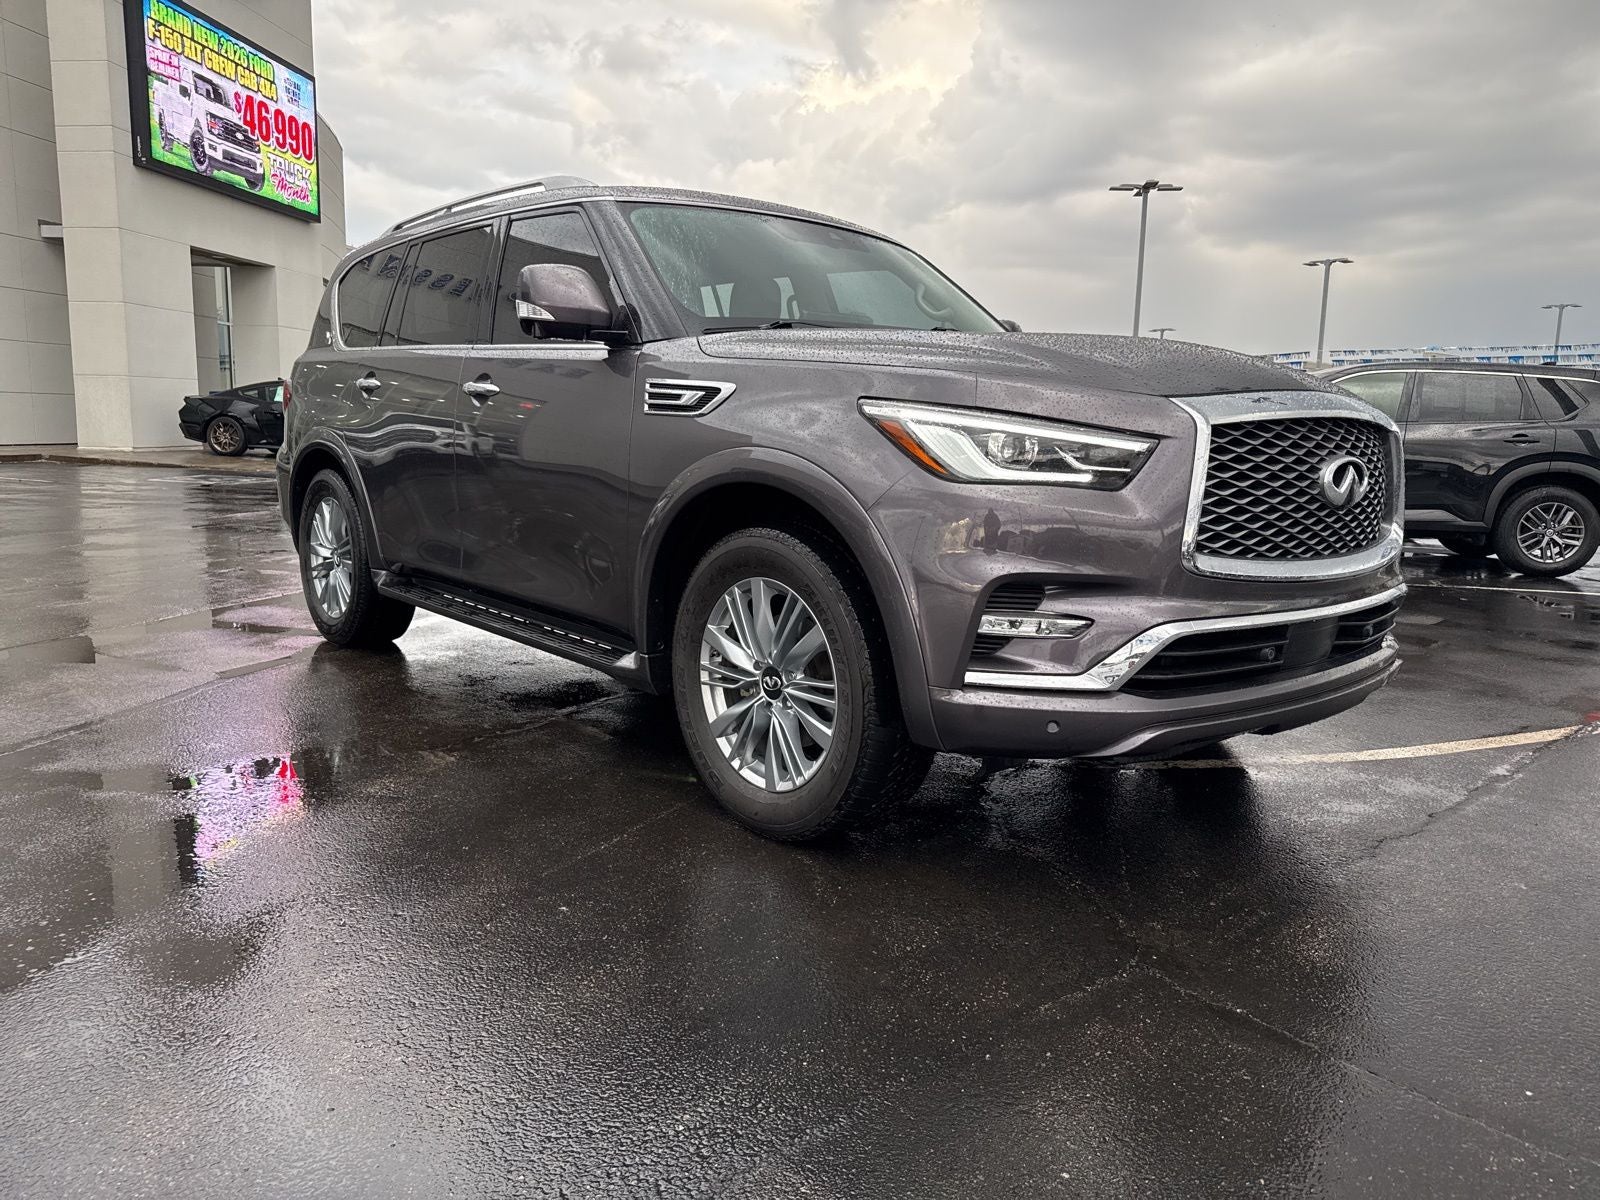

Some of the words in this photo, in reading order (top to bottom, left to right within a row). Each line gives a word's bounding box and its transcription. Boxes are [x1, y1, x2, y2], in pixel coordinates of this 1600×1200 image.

[147, 17, 182, 54] F-150
[204, 47, 236, 81] CREW
[237, 65, 258, 92] CAB
[150, 0, 191, 38] BRAND
[193, 21, 219, 53] NEW
[220, 36, 248, 68] 2026
[248, 51, 274, 82] FORD
[267, 152, 313, 191] TRUCK
